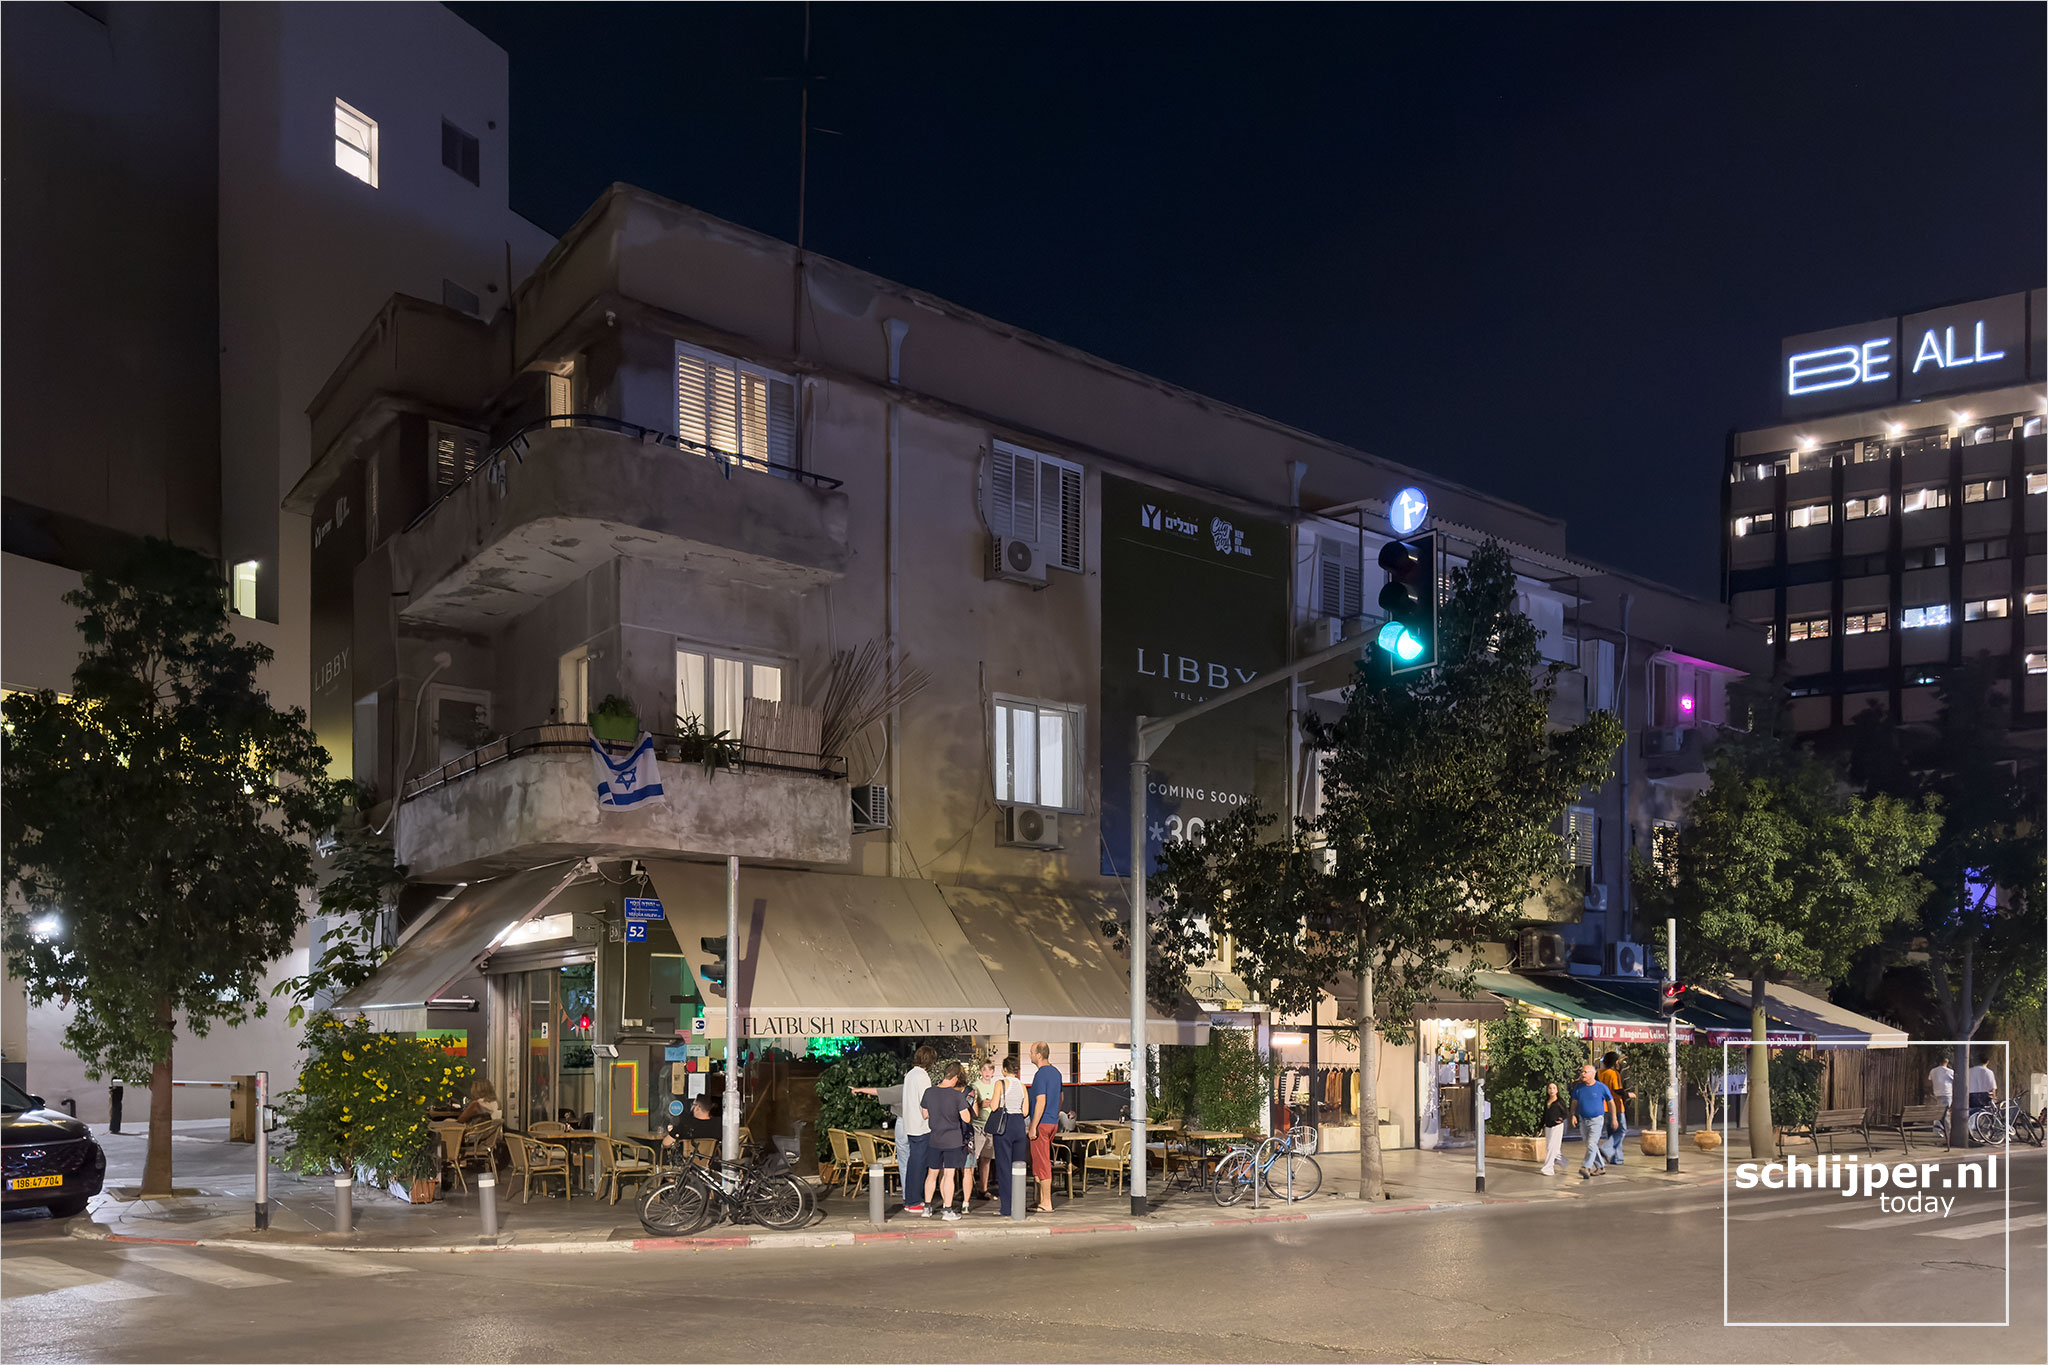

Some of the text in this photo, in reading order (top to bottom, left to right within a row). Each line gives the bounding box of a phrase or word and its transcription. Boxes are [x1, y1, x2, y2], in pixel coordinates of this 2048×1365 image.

[1788, 320, 2005, 396] BE ALL
[314, 647, 349, 692] LIBBY
[1137, 647, 1258, 689] LIBBY
[1173, 691, 1192, 701] TEL
[1148, 782, 1248, 807] COMING SOON
[629, 926, 645, 937] 52
[743, 1016, 834, 1035] FLATBUSH
[842, 1018, 932, 1034] RESTAURANT
[950, 1018, 979, 1033] BAR
[1586, 1025, 1617, 1039] TULIP
